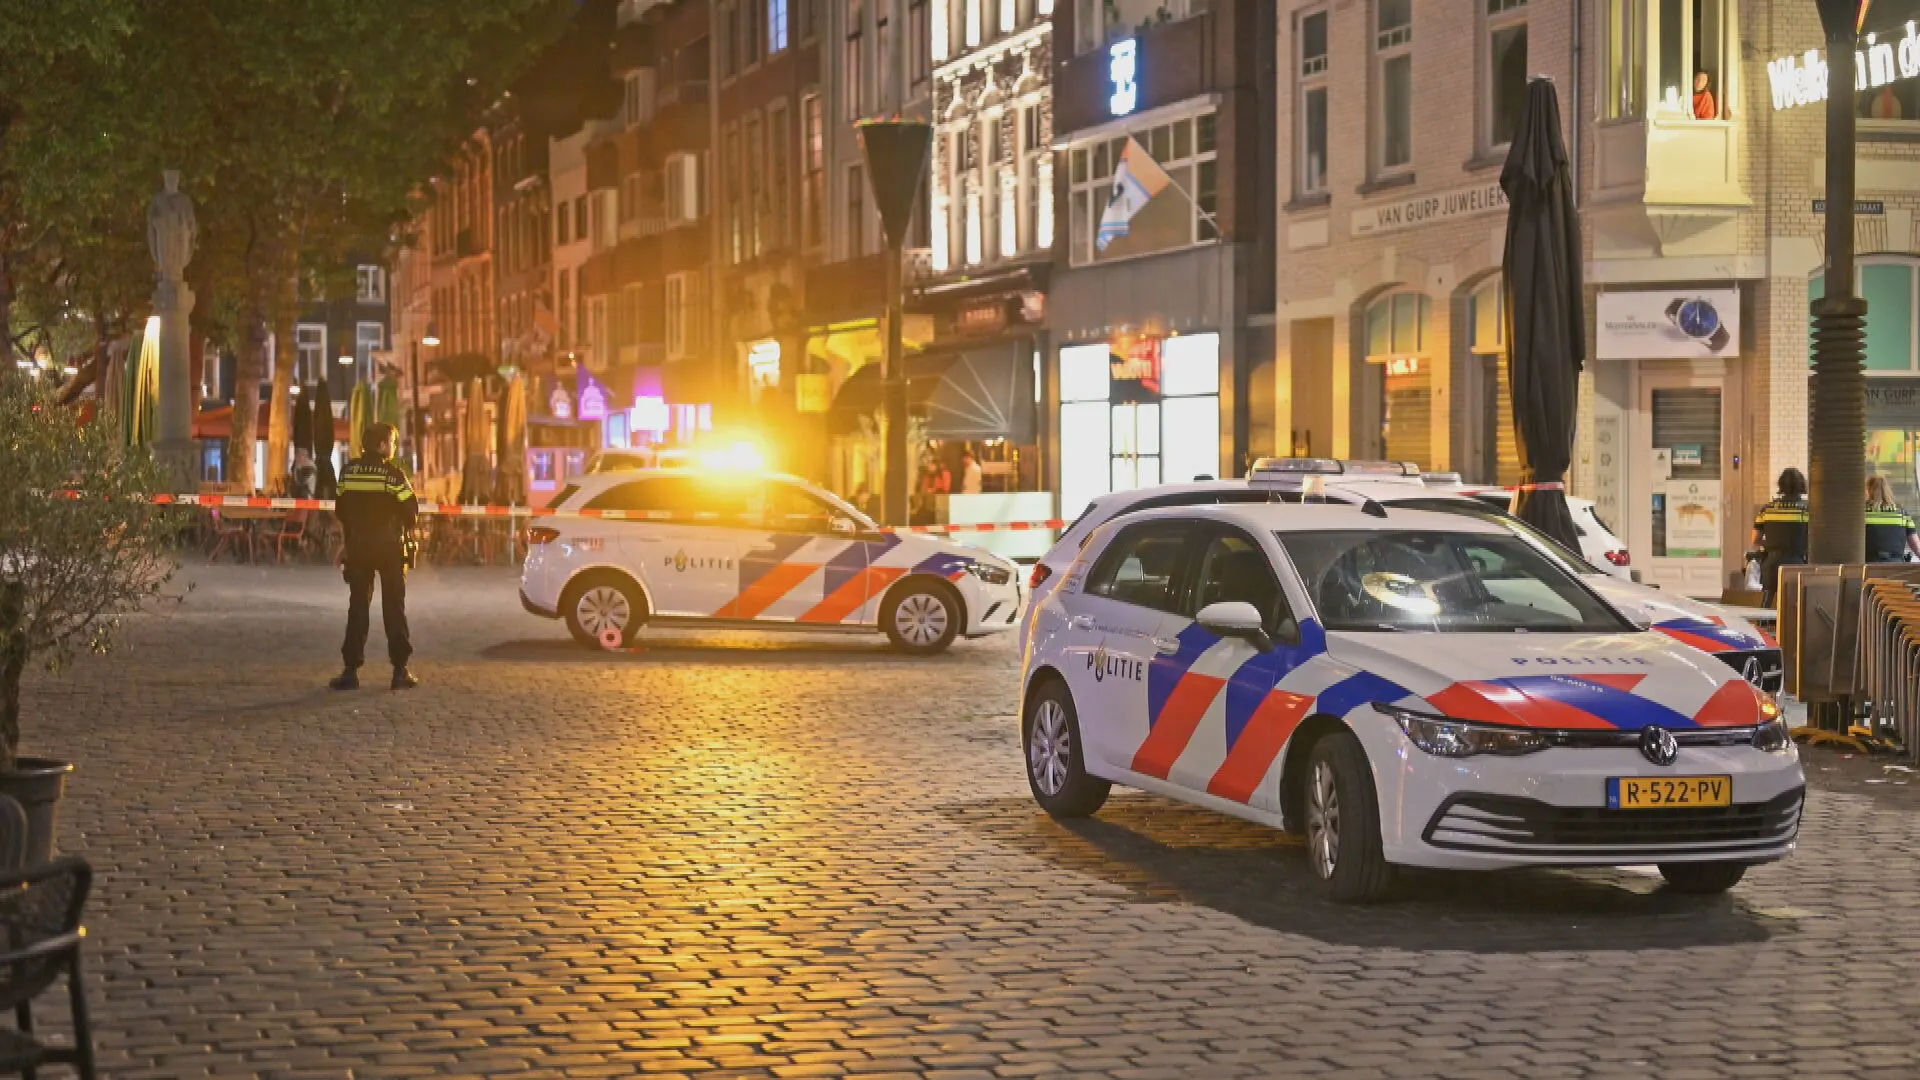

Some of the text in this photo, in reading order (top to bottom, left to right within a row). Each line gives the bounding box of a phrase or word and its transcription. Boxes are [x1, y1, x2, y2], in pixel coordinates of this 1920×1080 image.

[1867, 32, 1895, 88] in
[1898, 19, 1920, 79] d
[1377, 185, 1510, 225] VAN GURP JUWELIER
[664, 552, 735, 572] POLITIE
[1087, 650, 1142, 682] POLITIE
[1627, 781, 1722, 803] R-522-PV
